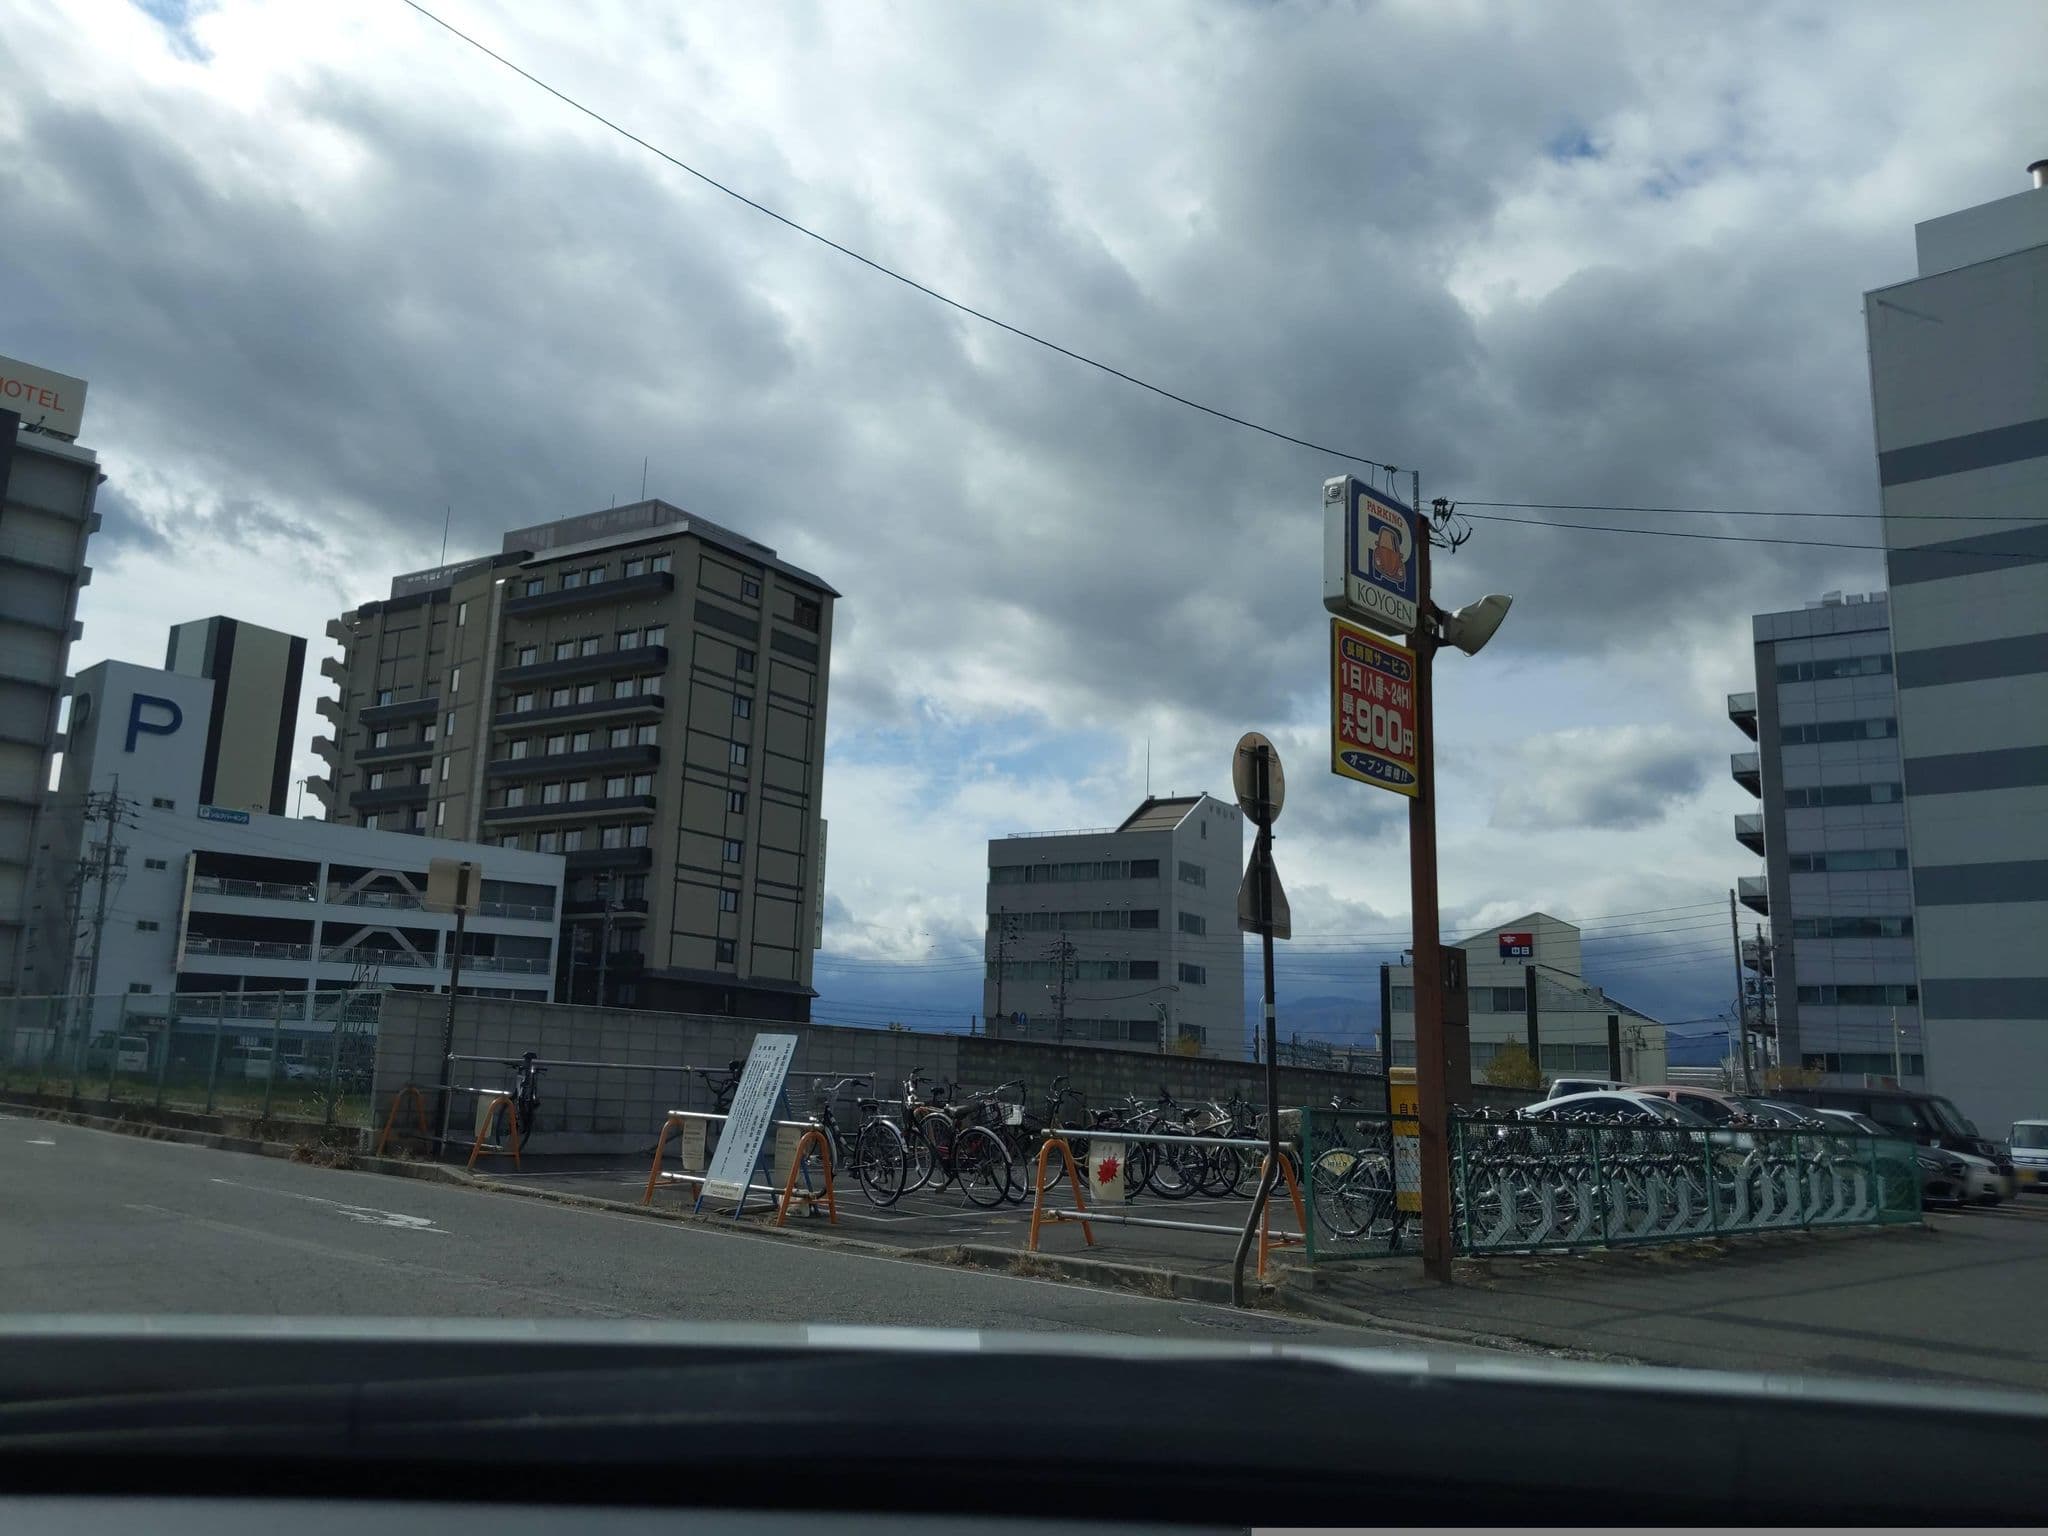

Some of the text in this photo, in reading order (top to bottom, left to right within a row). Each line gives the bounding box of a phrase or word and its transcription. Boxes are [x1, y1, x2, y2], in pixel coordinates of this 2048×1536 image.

[1366, 500, 1404, 528] PARKING
[1356, 582, 1412, 625] KOYOEN
[1346, 640, 1409, 677] 長時間サービス
[125, 692, 183, 752] P
[1341, 691, 1355, 739] 最大
[1356, 697, 1414, 757] 900円
